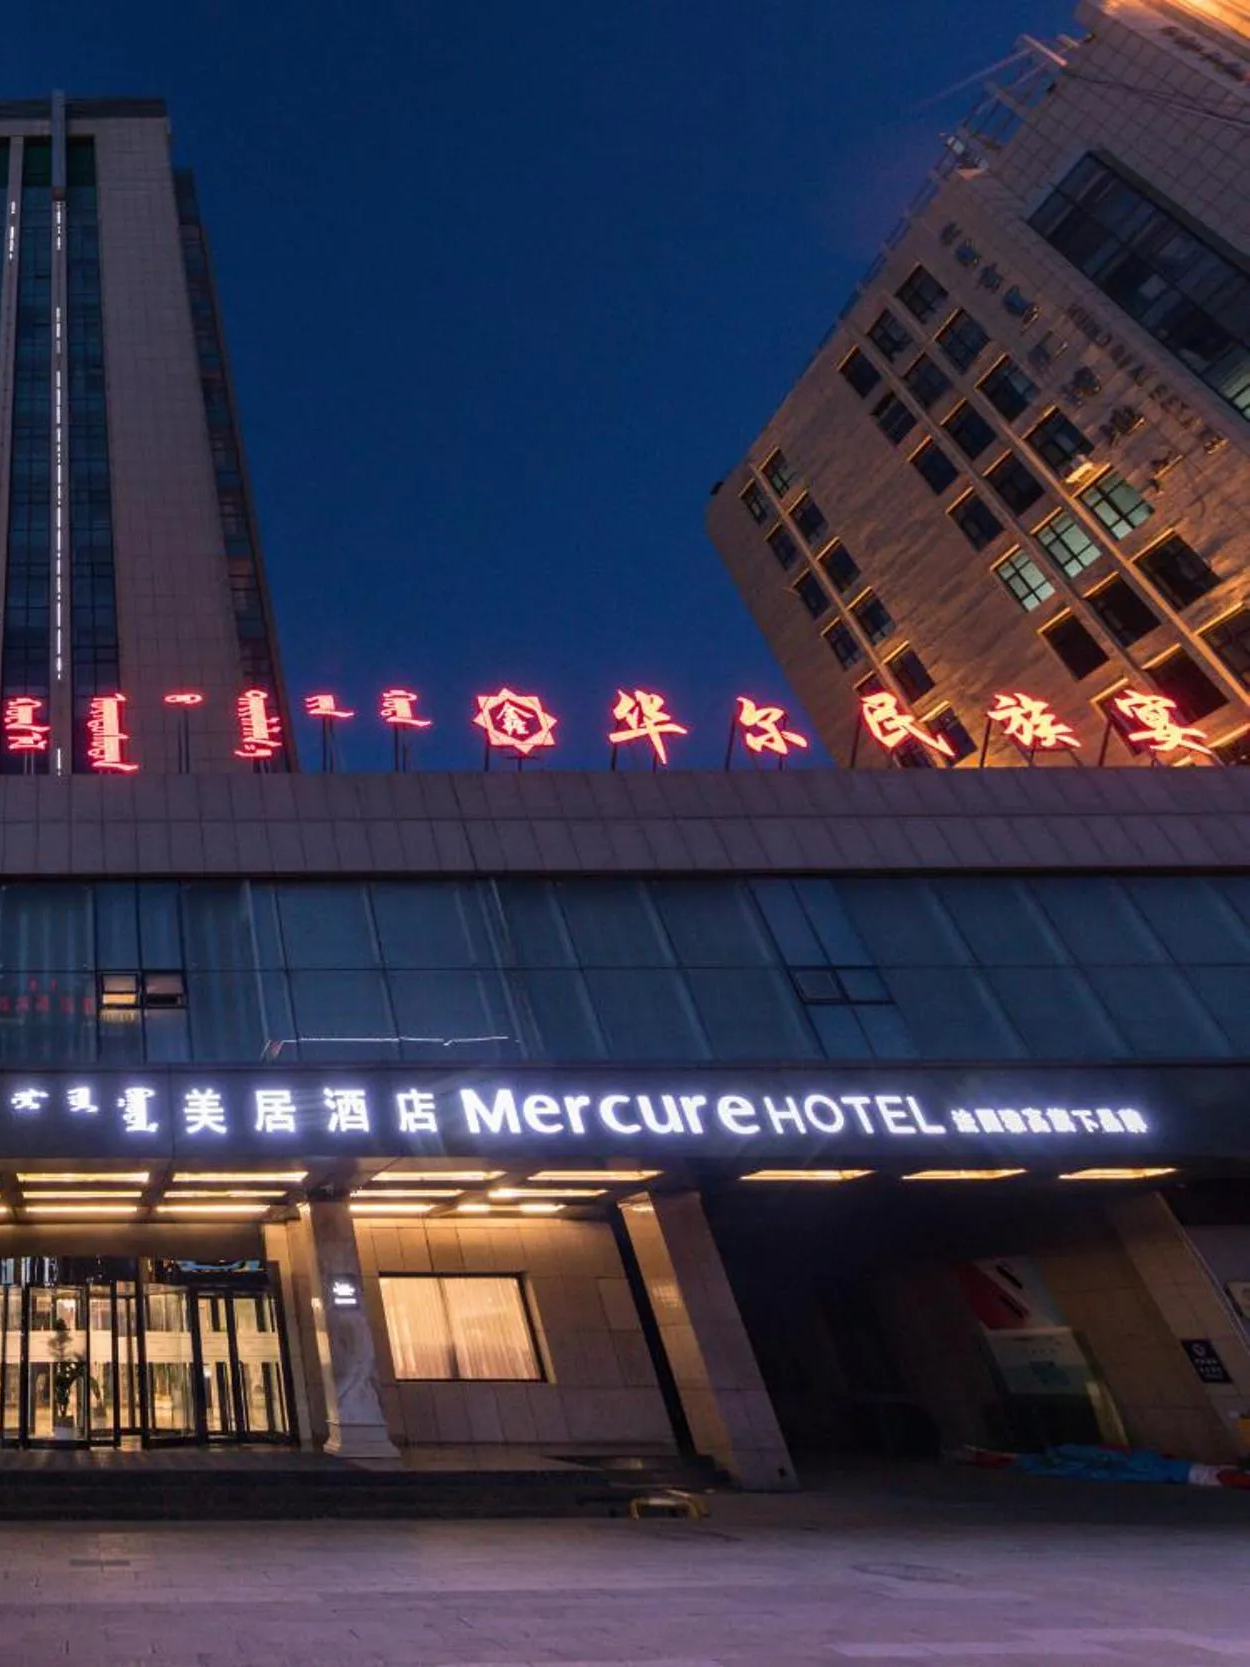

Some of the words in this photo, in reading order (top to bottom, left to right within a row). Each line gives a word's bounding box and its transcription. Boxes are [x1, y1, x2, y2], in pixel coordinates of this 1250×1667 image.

[184, 1087, 439, 1135] 美居酒店
[459, 1087, 761, 1135] Mercure
[763, 1094, 946, 1135] HOTEL
